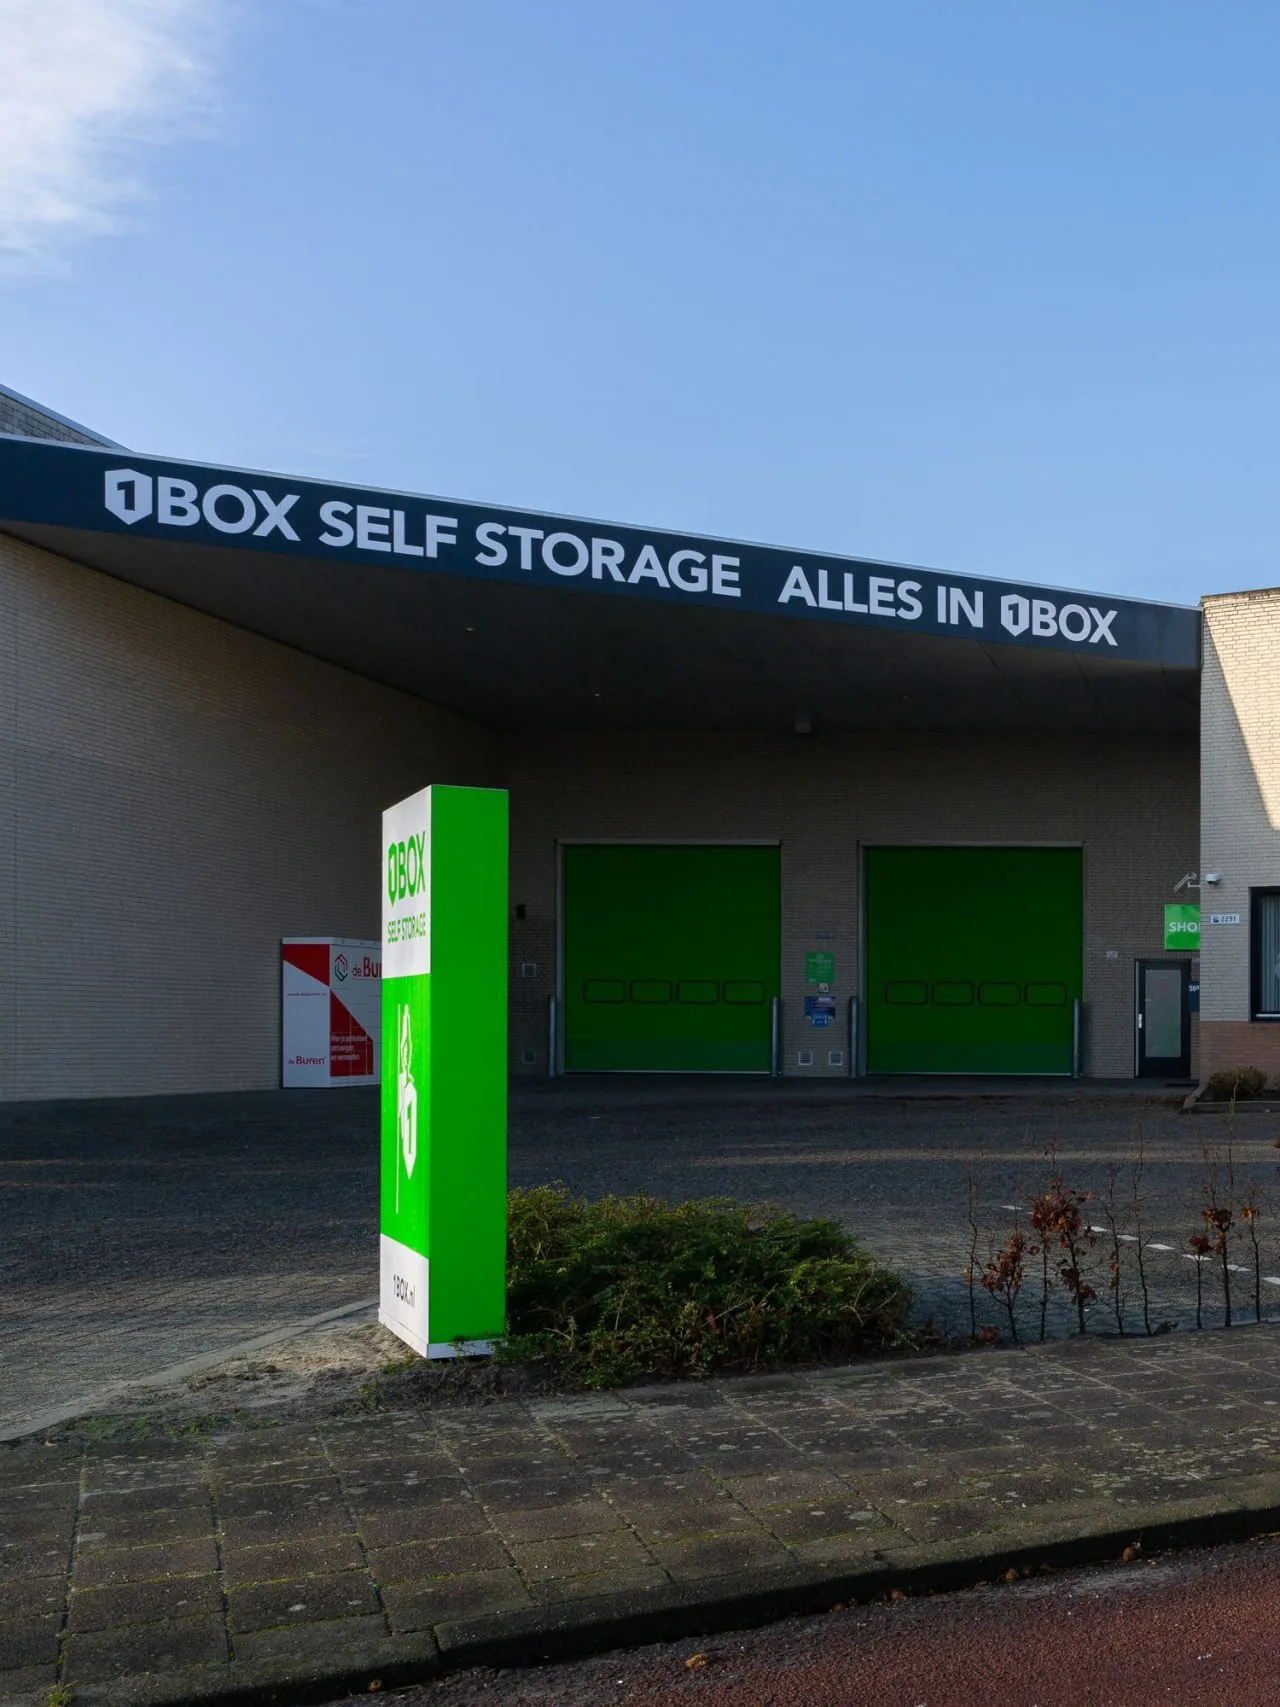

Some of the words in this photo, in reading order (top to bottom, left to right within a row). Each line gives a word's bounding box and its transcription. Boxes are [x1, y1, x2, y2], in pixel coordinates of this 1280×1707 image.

[104, 468, 301, 541] 1BOX
[318, 500, 459, 558] SELF
[474, 521, 742, 597] STORAGE
[777, 565, 923, 621] ALLES
[937, 585, 984, 629] IN
[1000, 593, 1118, 646] 1BOX
[387, 919, 401, 943] SELF
[402, 912, 426, 940] STORAGE
[1168, 921, 1200, 933] SHO
